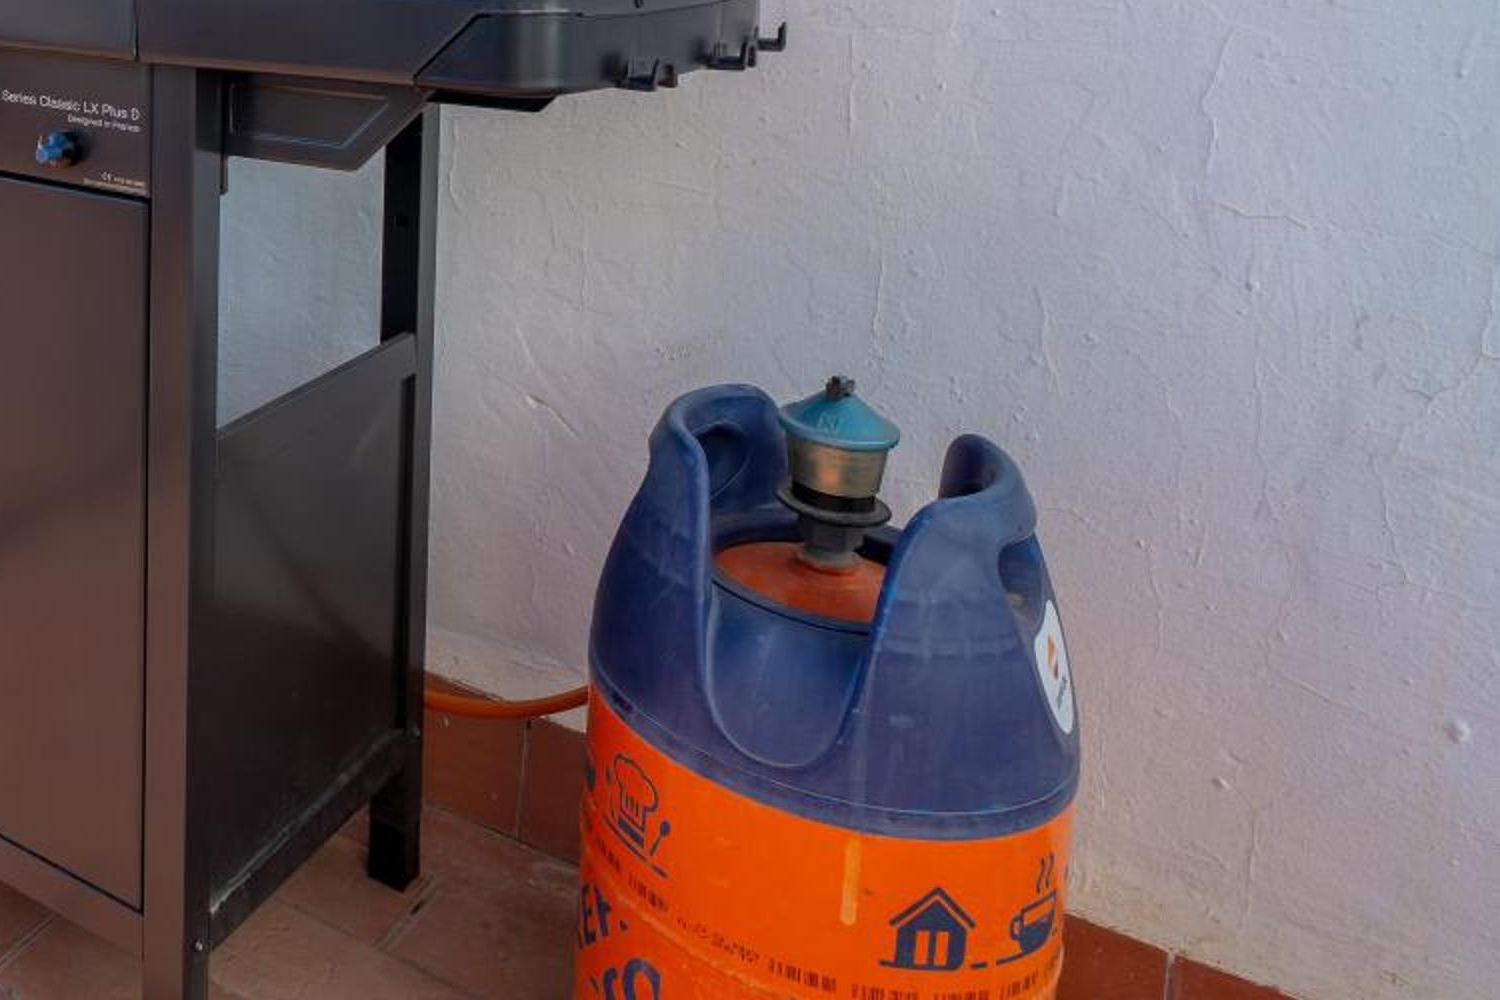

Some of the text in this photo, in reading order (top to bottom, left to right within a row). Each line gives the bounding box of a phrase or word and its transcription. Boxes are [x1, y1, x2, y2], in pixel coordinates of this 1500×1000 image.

[2, 89, 37, 105] Series
[39, 94, 81, 111] Classic
[83, 101, 99, 115] LX
[101, 103, 127, 119] Plus
